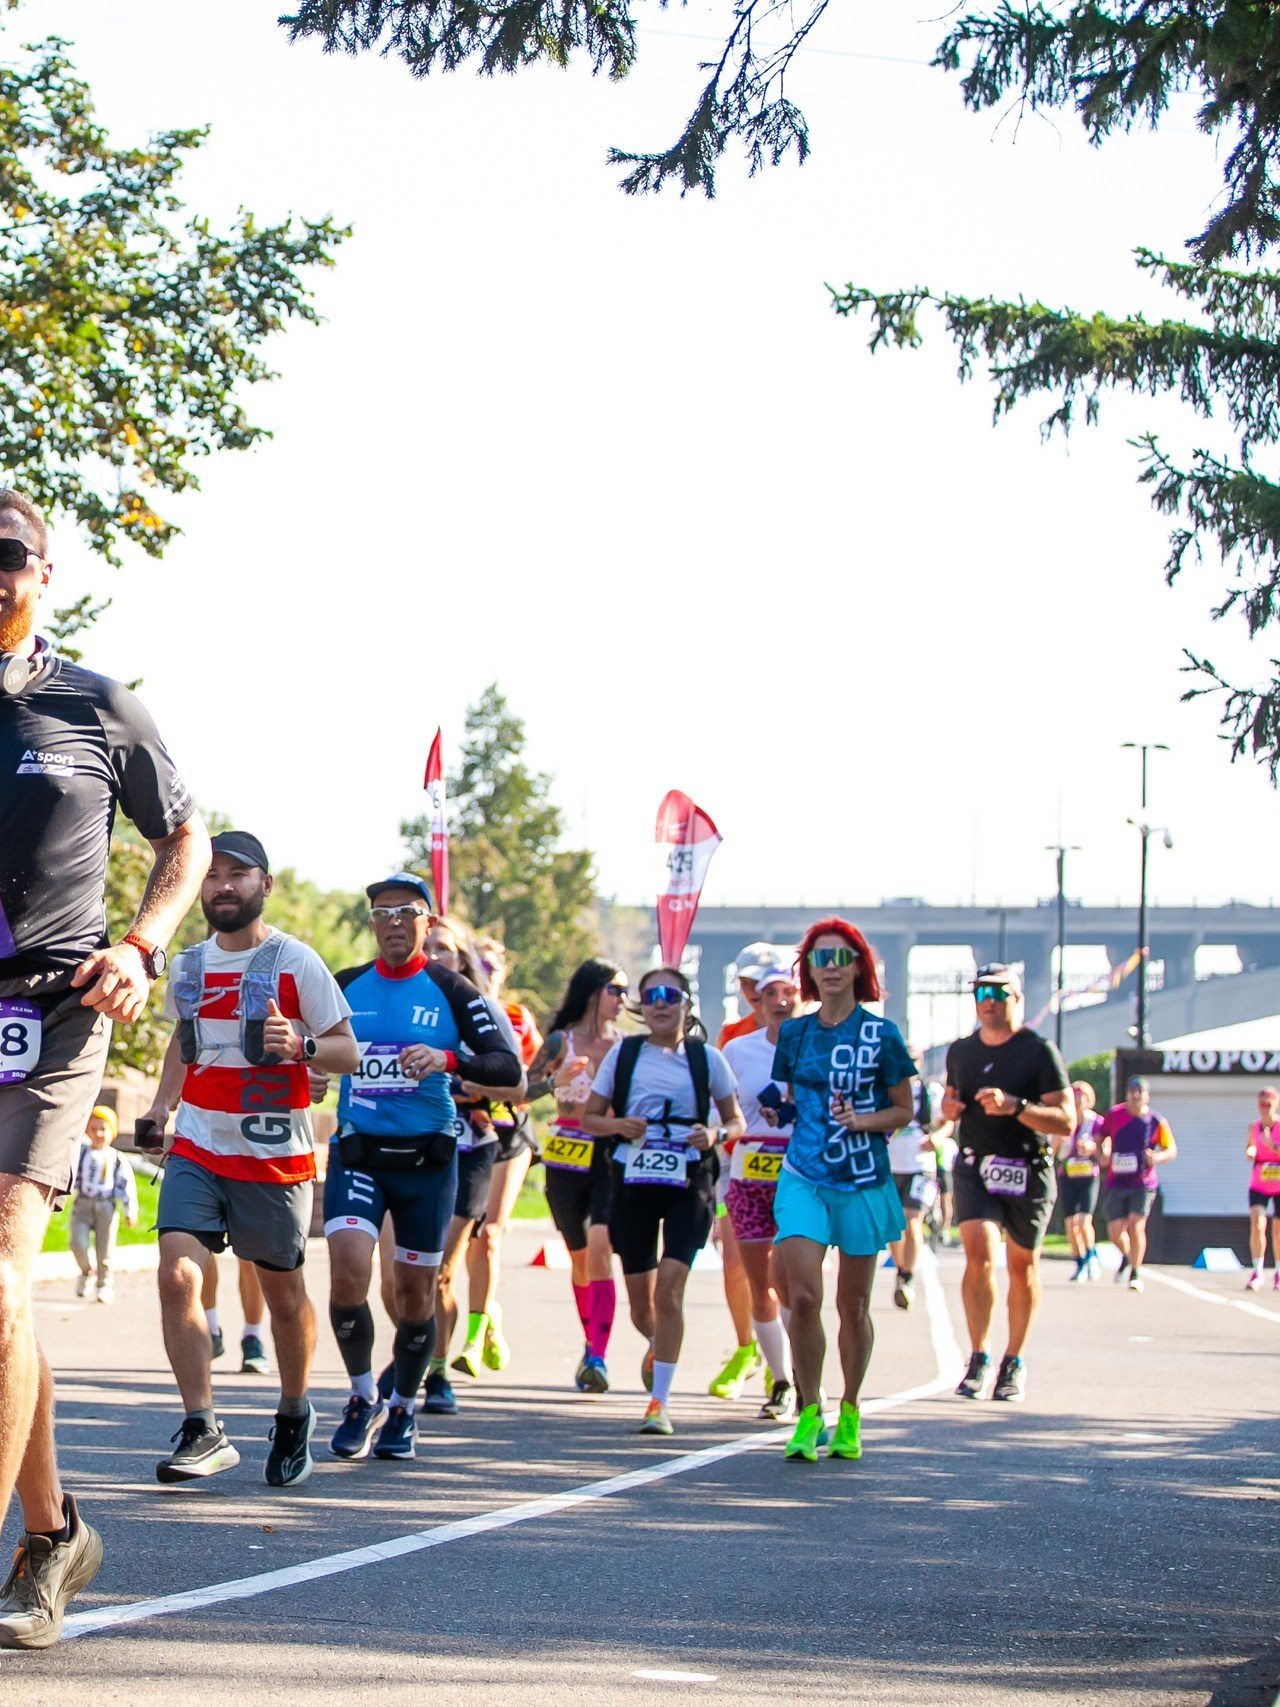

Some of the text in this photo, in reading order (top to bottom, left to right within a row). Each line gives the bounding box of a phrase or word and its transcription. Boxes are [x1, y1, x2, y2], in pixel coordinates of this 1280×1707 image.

[412, 1005, 440, 1027] Tri
[546, 1139, 589, 1159] 4277
[632, 1152, 679, 1172] 4:29
[748, 1155, 783, 1173] 427
